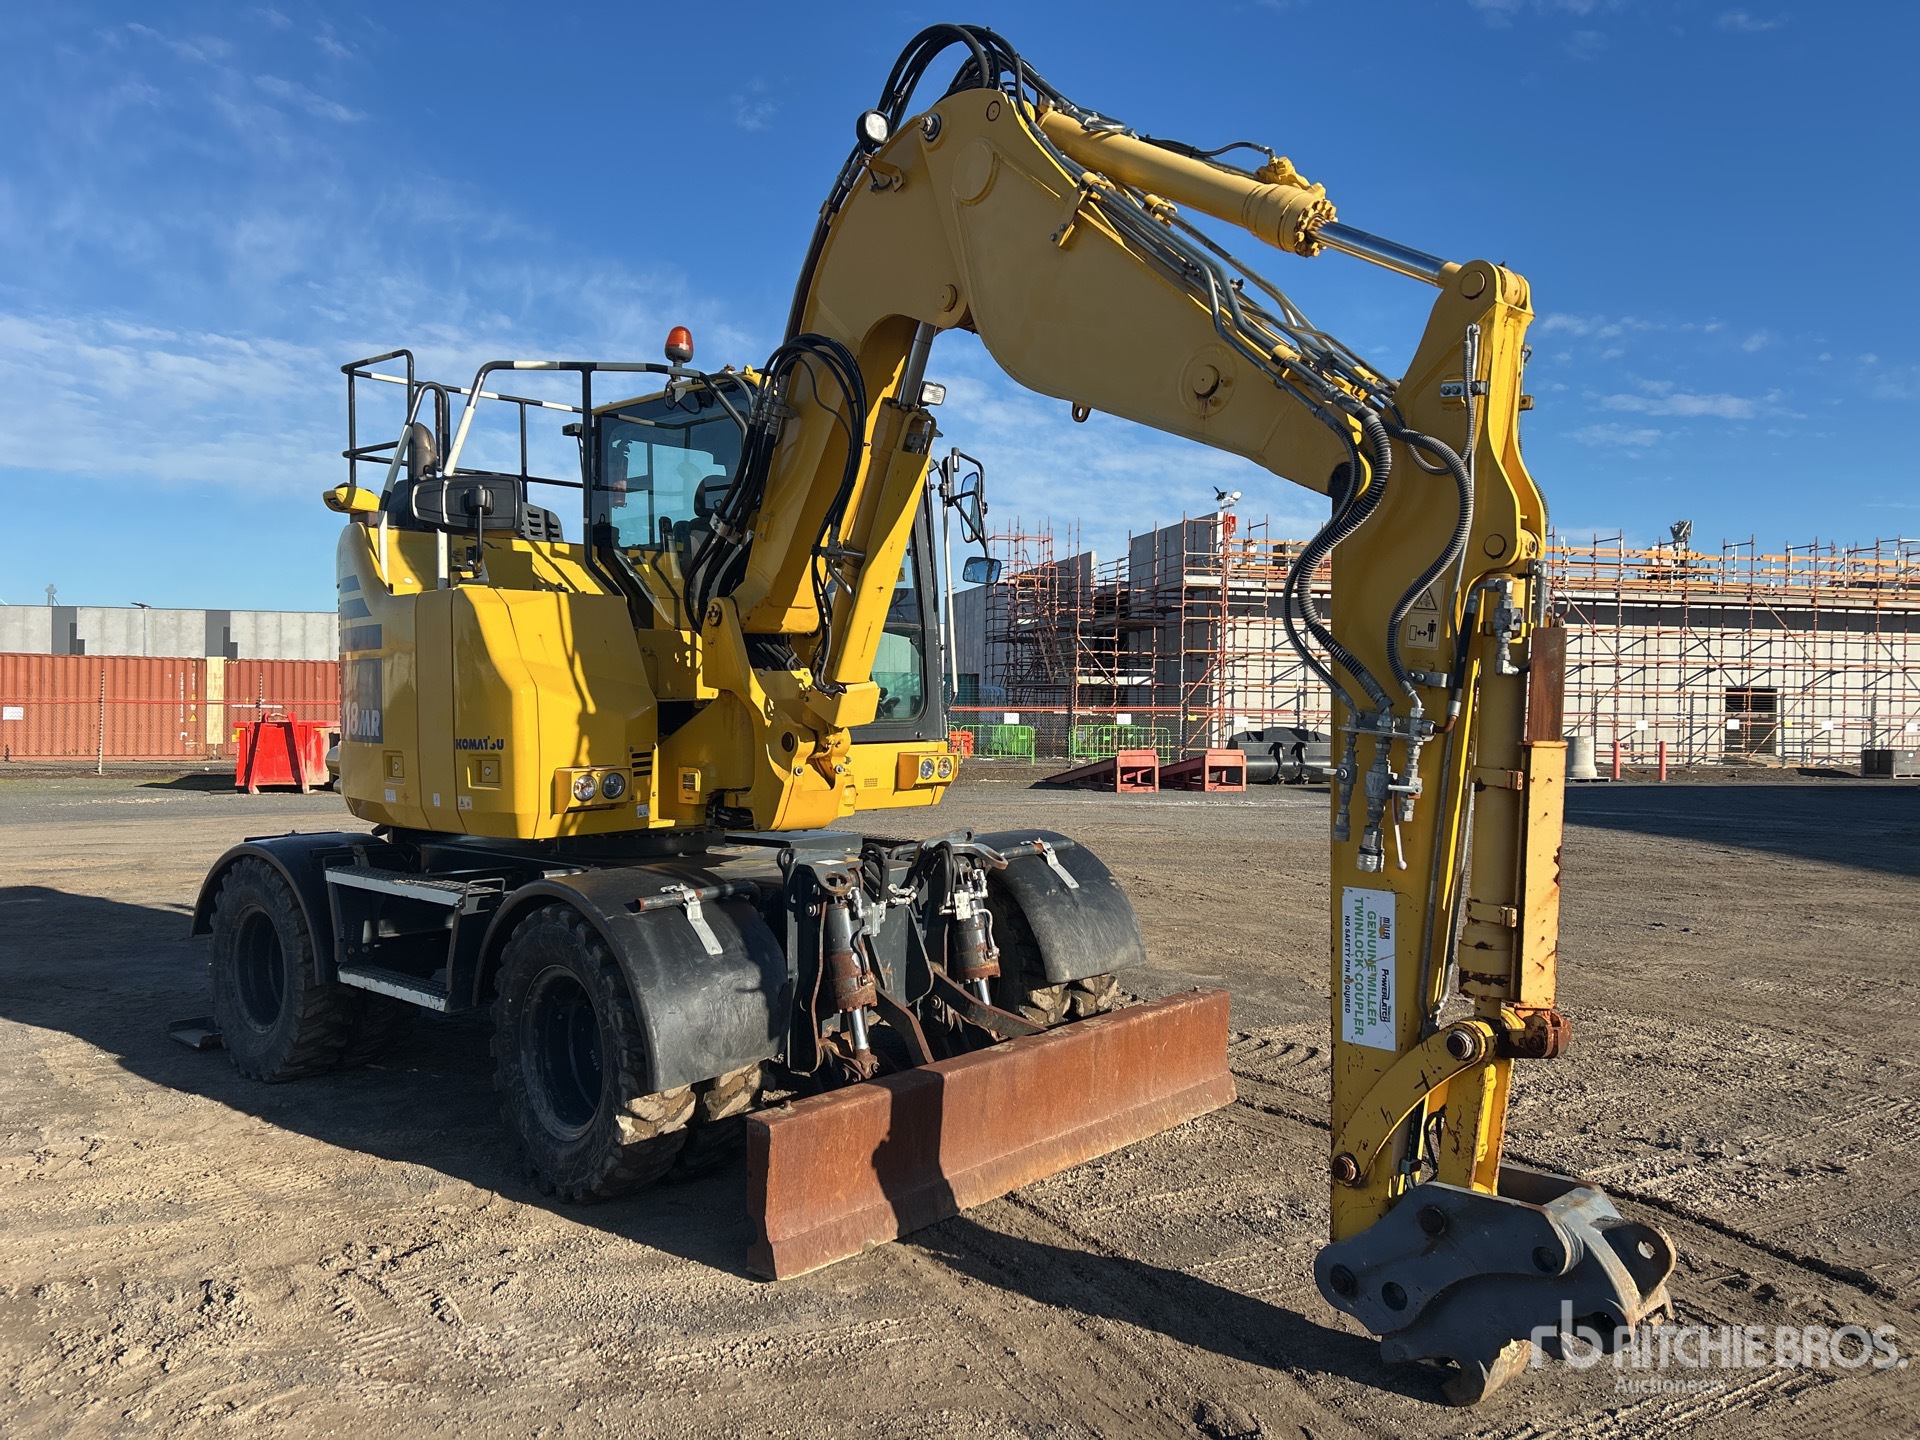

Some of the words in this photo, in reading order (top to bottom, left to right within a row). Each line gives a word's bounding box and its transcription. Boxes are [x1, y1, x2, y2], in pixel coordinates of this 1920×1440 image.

[455, 735, 505, 751] KOMATSU
[1344, 915, 1351, 927] NO
[1354, 897, 1364, 968] TWINLOCK
[1367, 910, 1377, 972] GENUINE
[1354, 972, 1364, 1036] COUPLER
[1367, 975, 1377, 1027] MILLER
